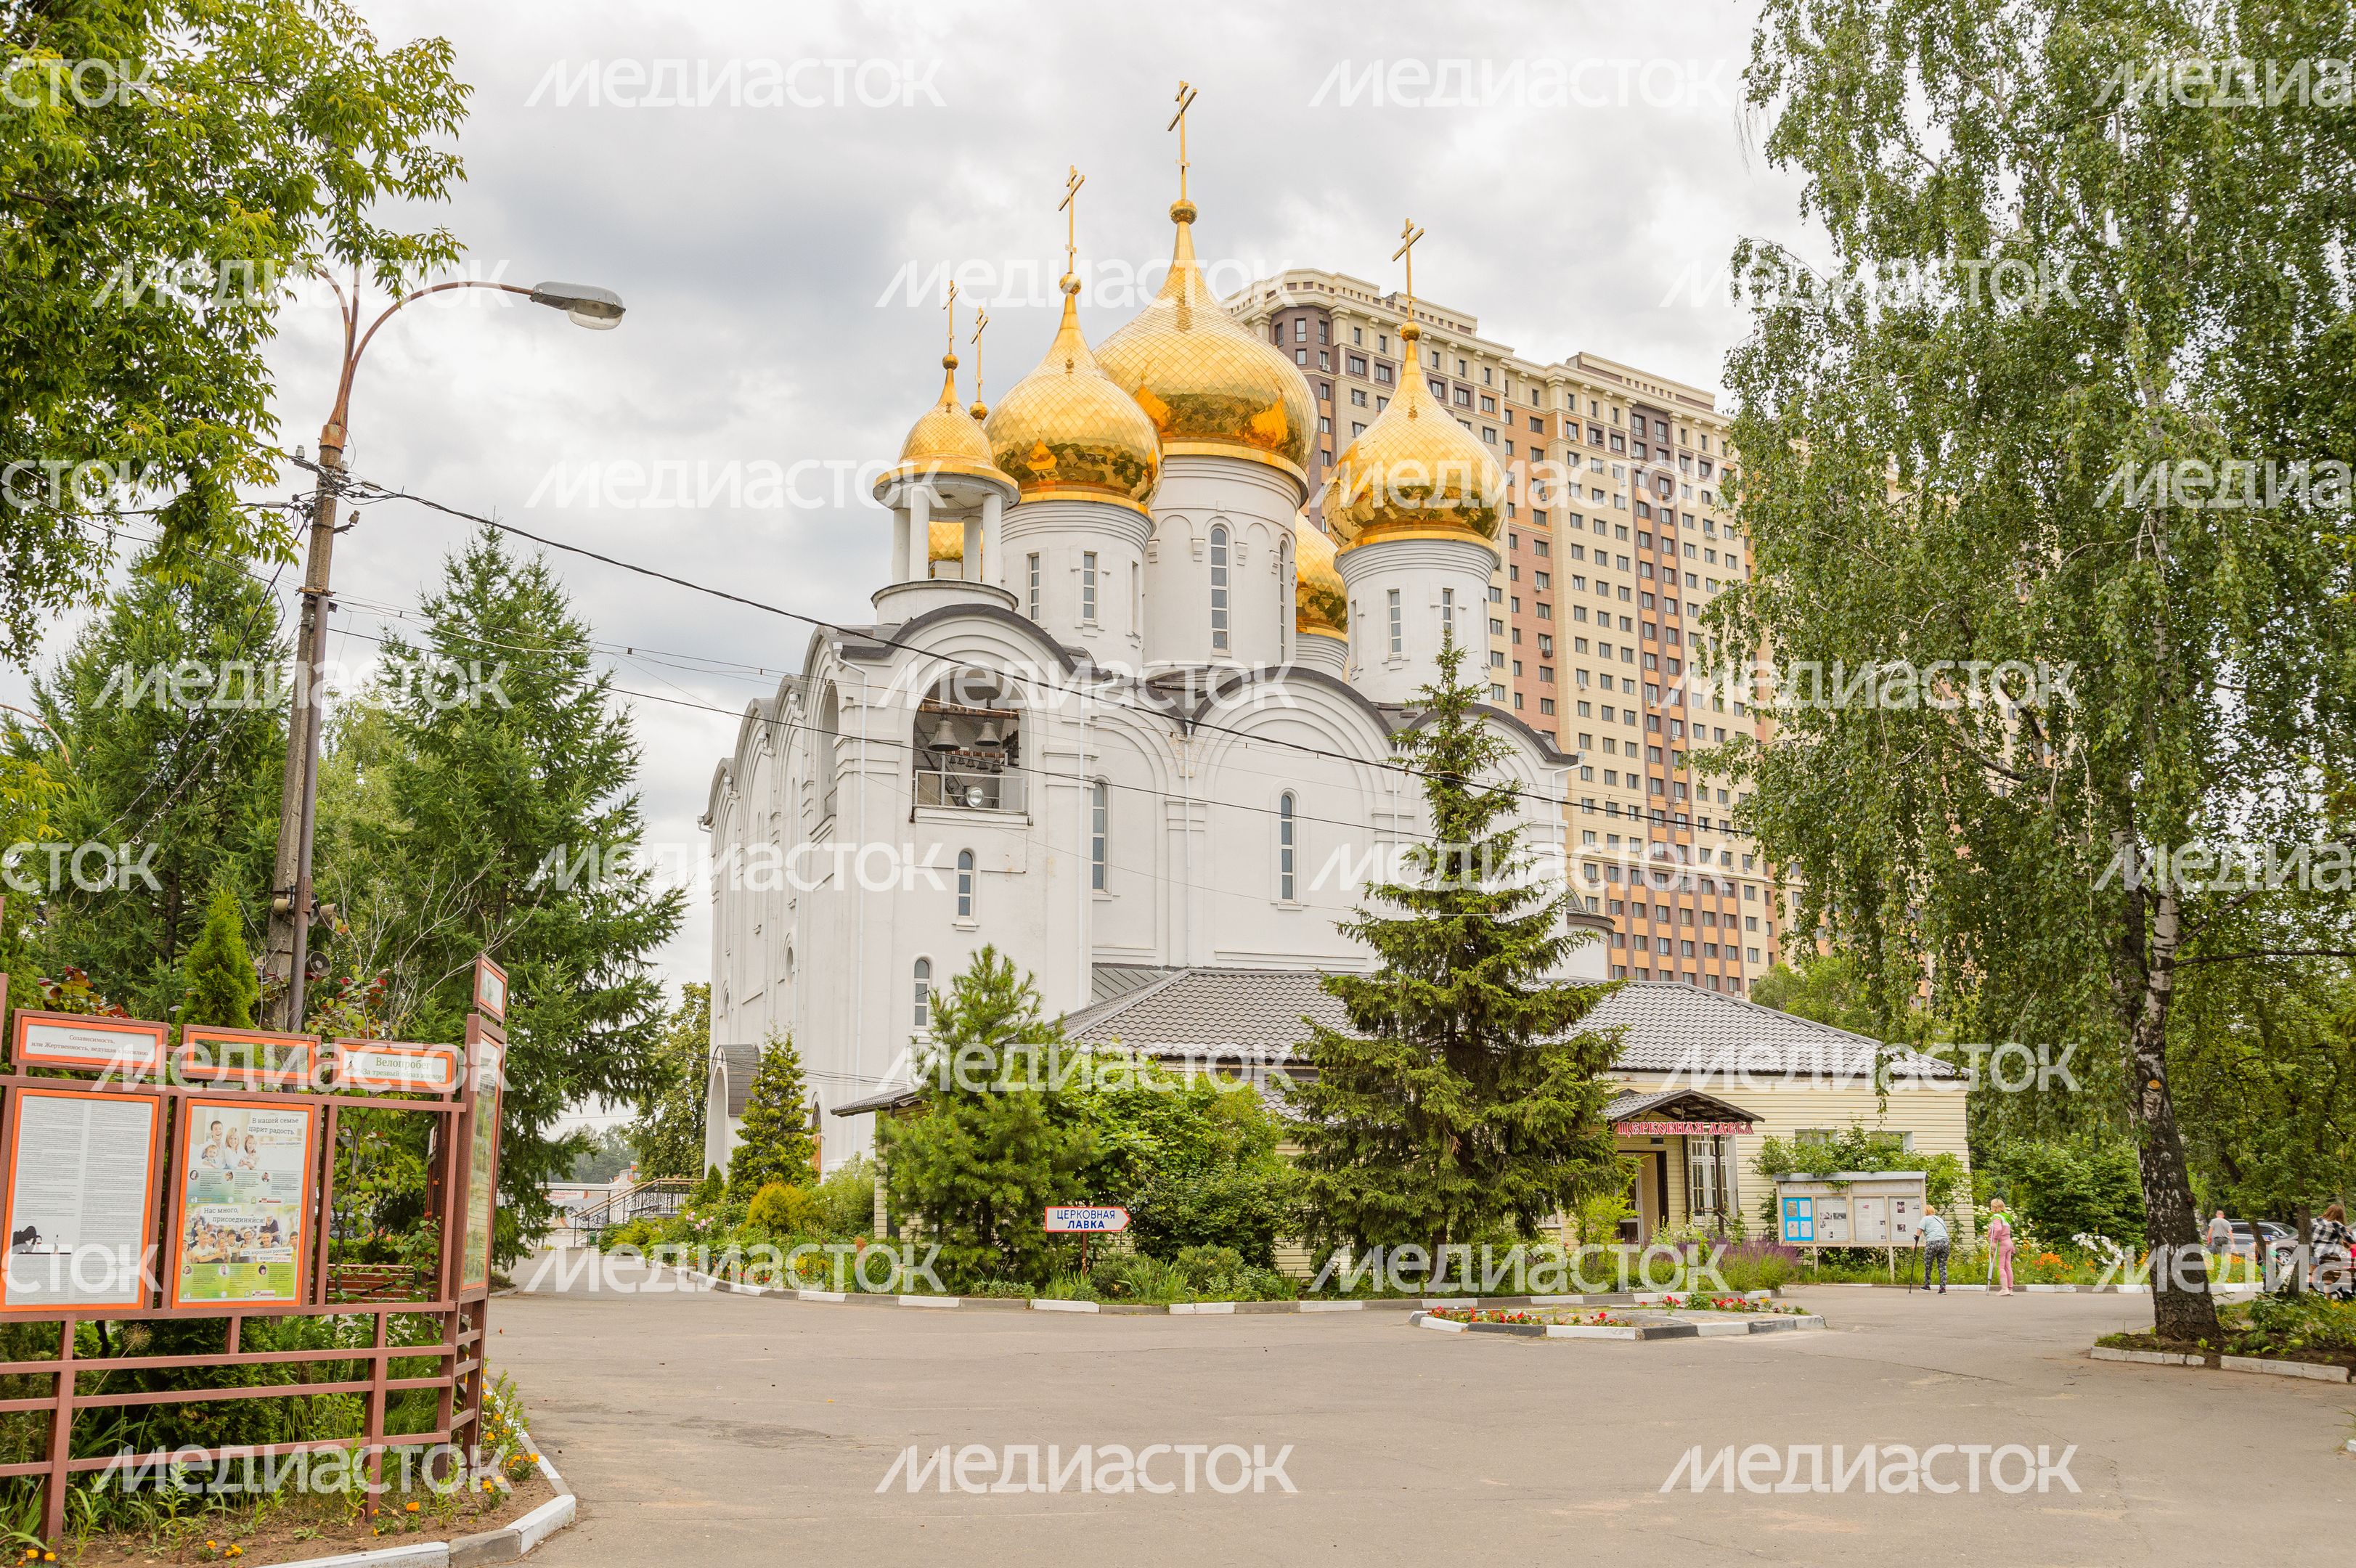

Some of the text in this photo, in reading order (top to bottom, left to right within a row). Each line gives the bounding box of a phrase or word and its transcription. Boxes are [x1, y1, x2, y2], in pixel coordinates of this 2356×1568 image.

[69, 1034, 115, 1045] Созависимость,
[44, 1042, 90, 1052] Жертвенность,
[375, 1057, 431, 1071] Велопробег
[1618, 1121, 1754, 1138] ЦЕРКОВНАЯ ЛАВКА
[1057, 1210, 1115, 1220] ЦЕРКОВНАЯ
[1067, 1220, 1105, 1229] ЛАВКА
